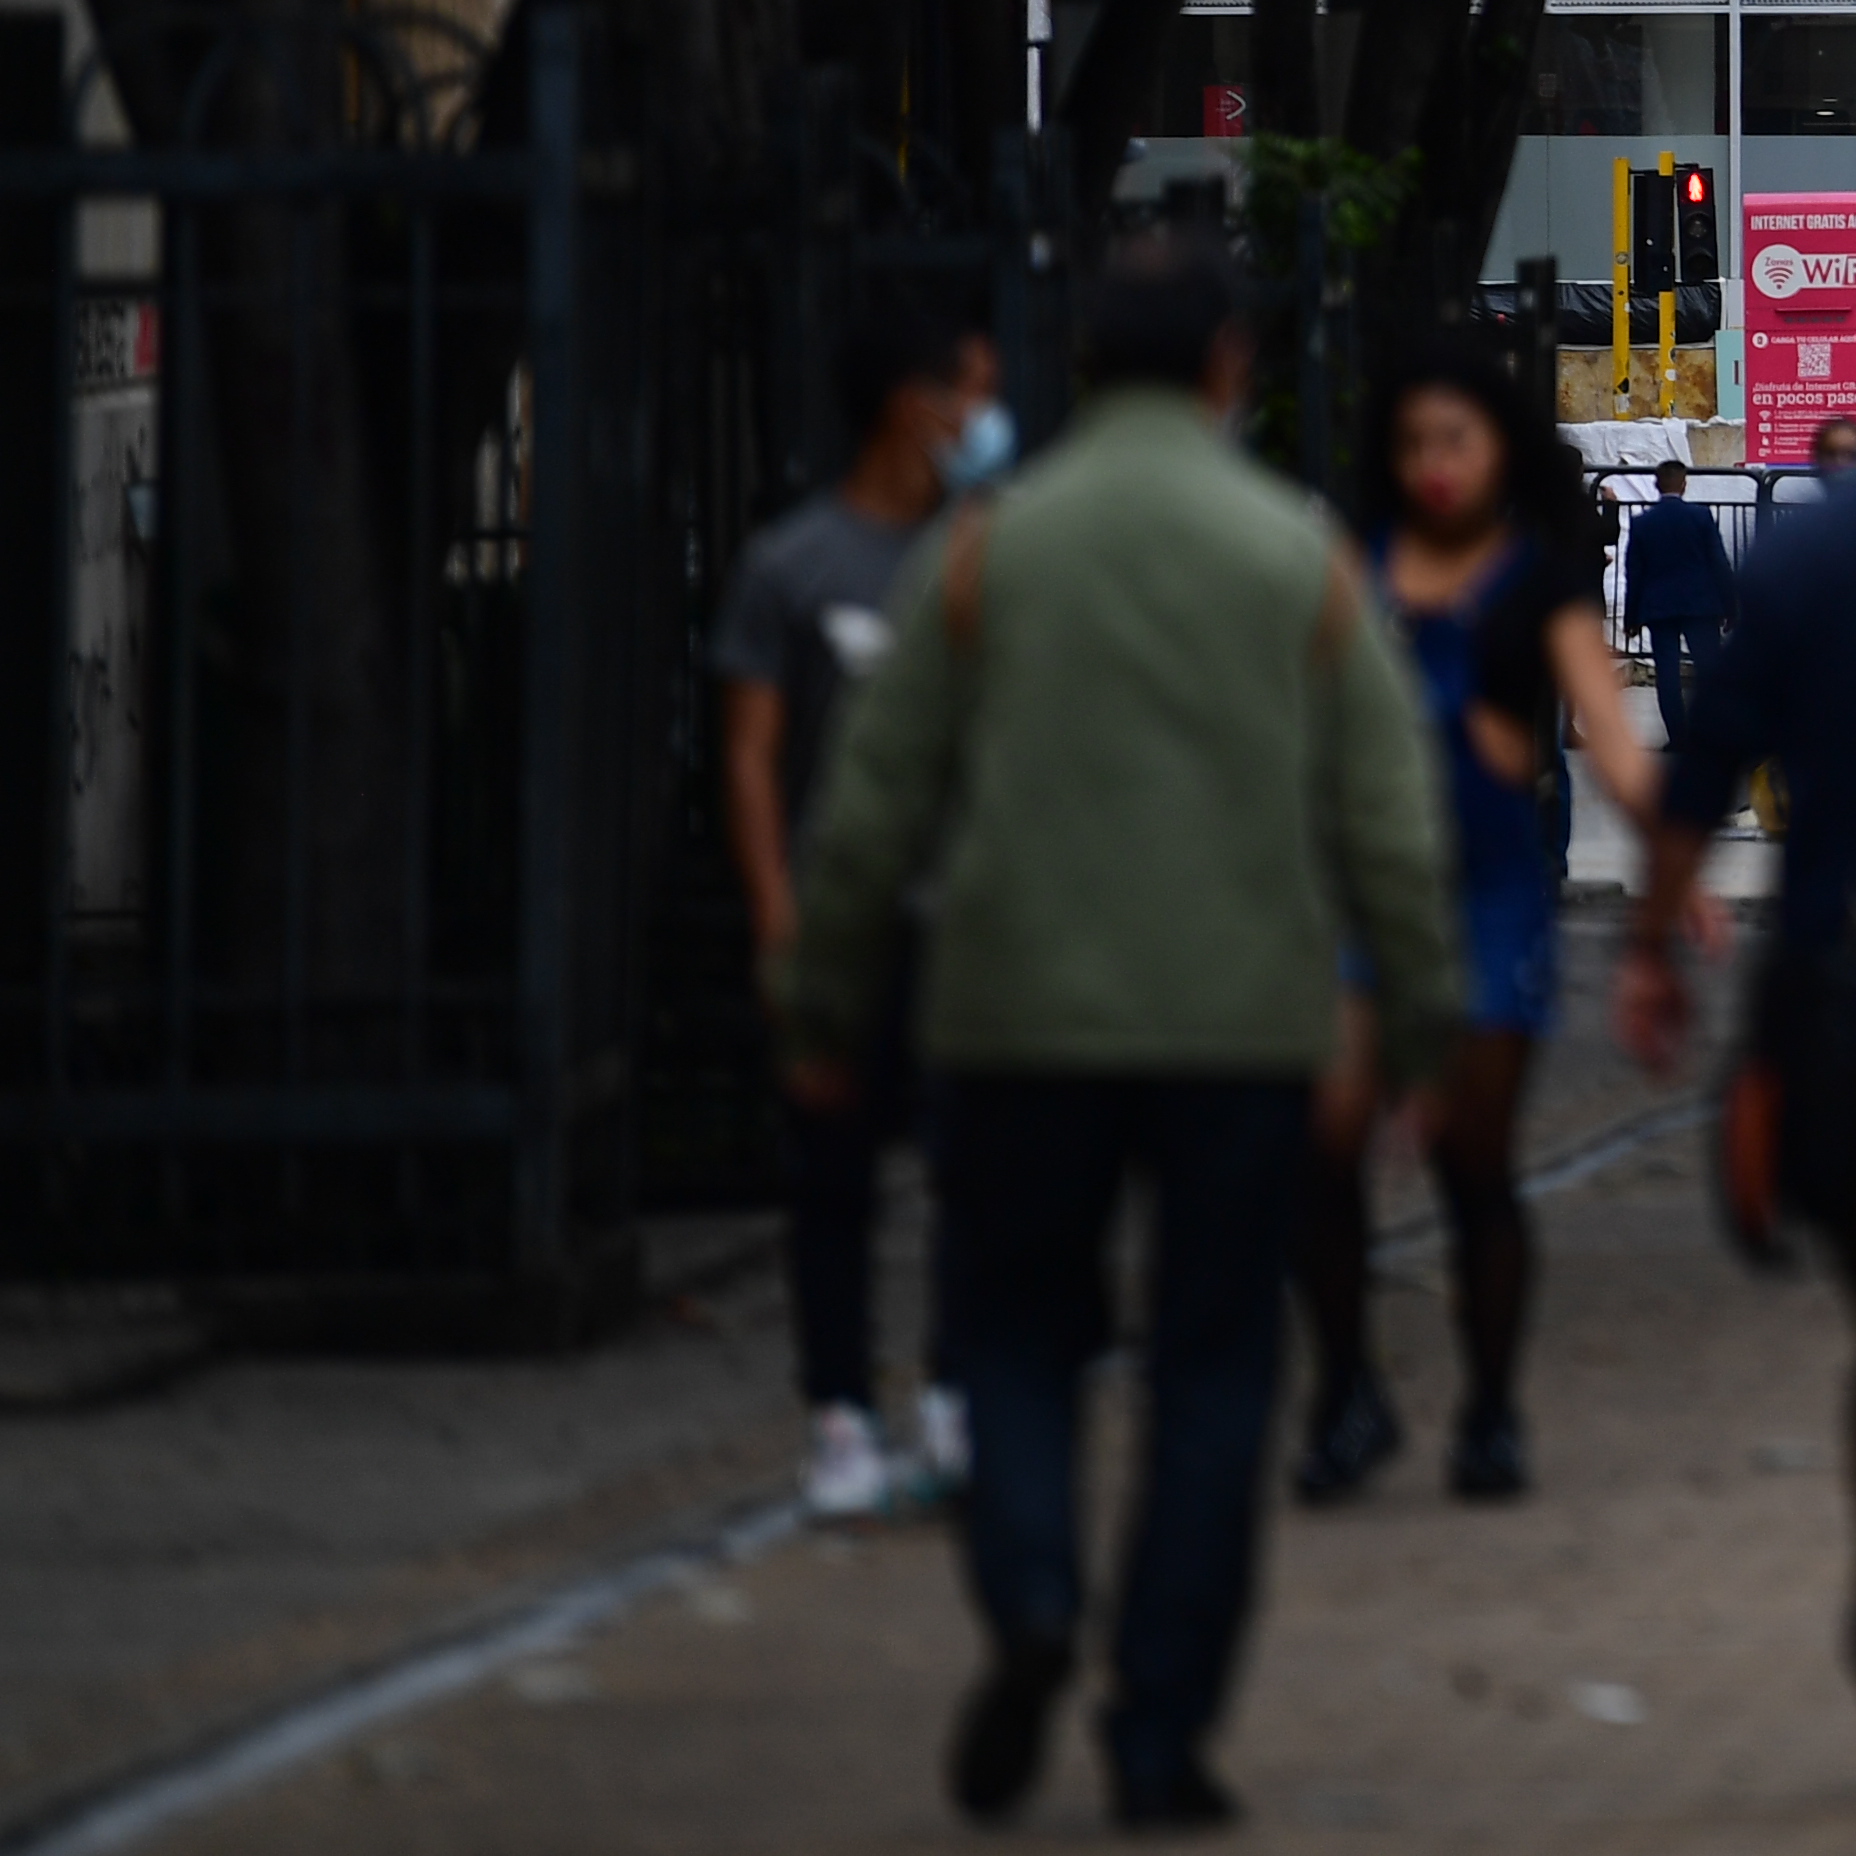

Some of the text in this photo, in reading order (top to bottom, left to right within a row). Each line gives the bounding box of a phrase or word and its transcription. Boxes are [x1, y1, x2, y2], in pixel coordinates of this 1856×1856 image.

[1751, 214, 1804, 231] INTERNET
[1806, 214, 1846, 229] GRATIS
[1764, 257, 1793, 266] Zonas
[1792, 382, 1804, 391] de
[1806, 382, 1841, 391] Internet
[1753, 393, 1773, 405] en
[1777, 392, 1824, 408] pocos
